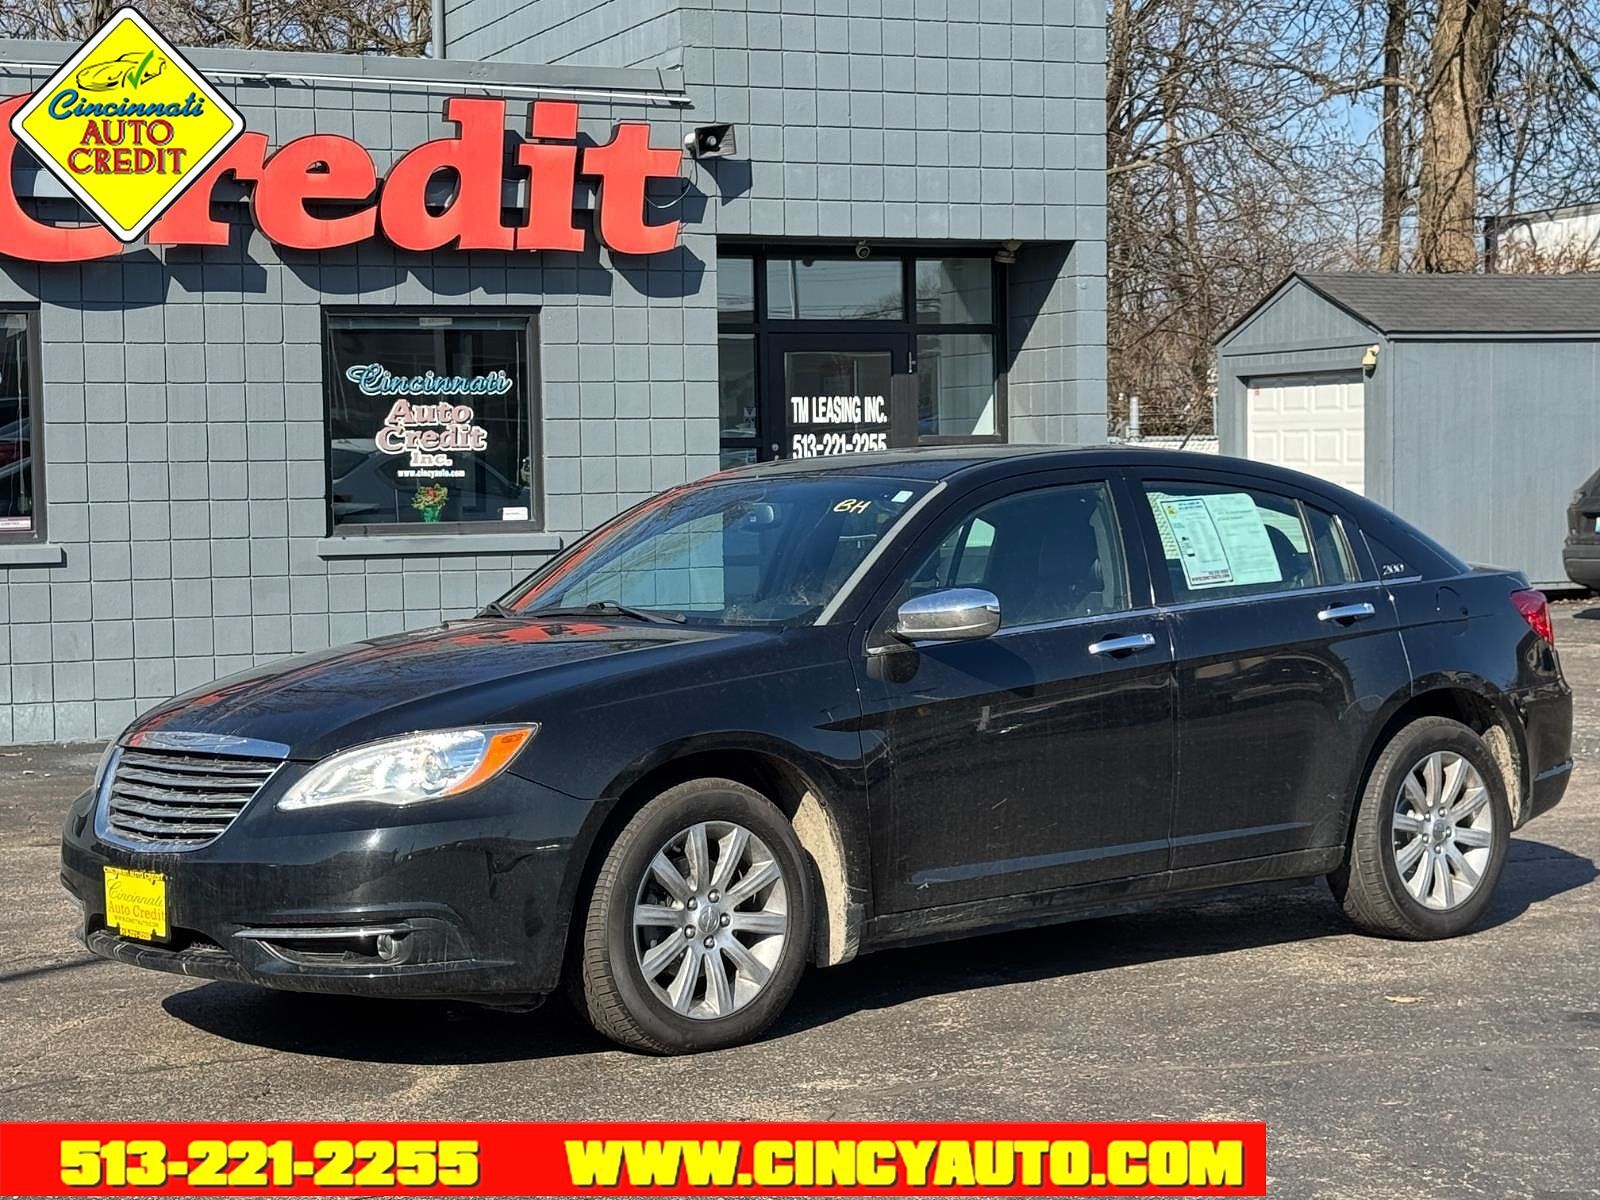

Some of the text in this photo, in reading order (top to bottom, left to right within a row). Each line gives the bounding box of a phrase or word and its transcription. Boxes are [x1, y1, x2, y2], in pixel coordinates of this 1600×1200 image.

[346, 363, 513, 396] Cincinnati
[384, 399, 473, 426] Auto
[791, 396, 888, 423] TM LEASING INC.
[375, 424, 488, 454] Credit
[410, 451, 453, 467] Inc.
[107, 879, 163, 906] Cincinnati
[108, 901, 130, 915] Auto
